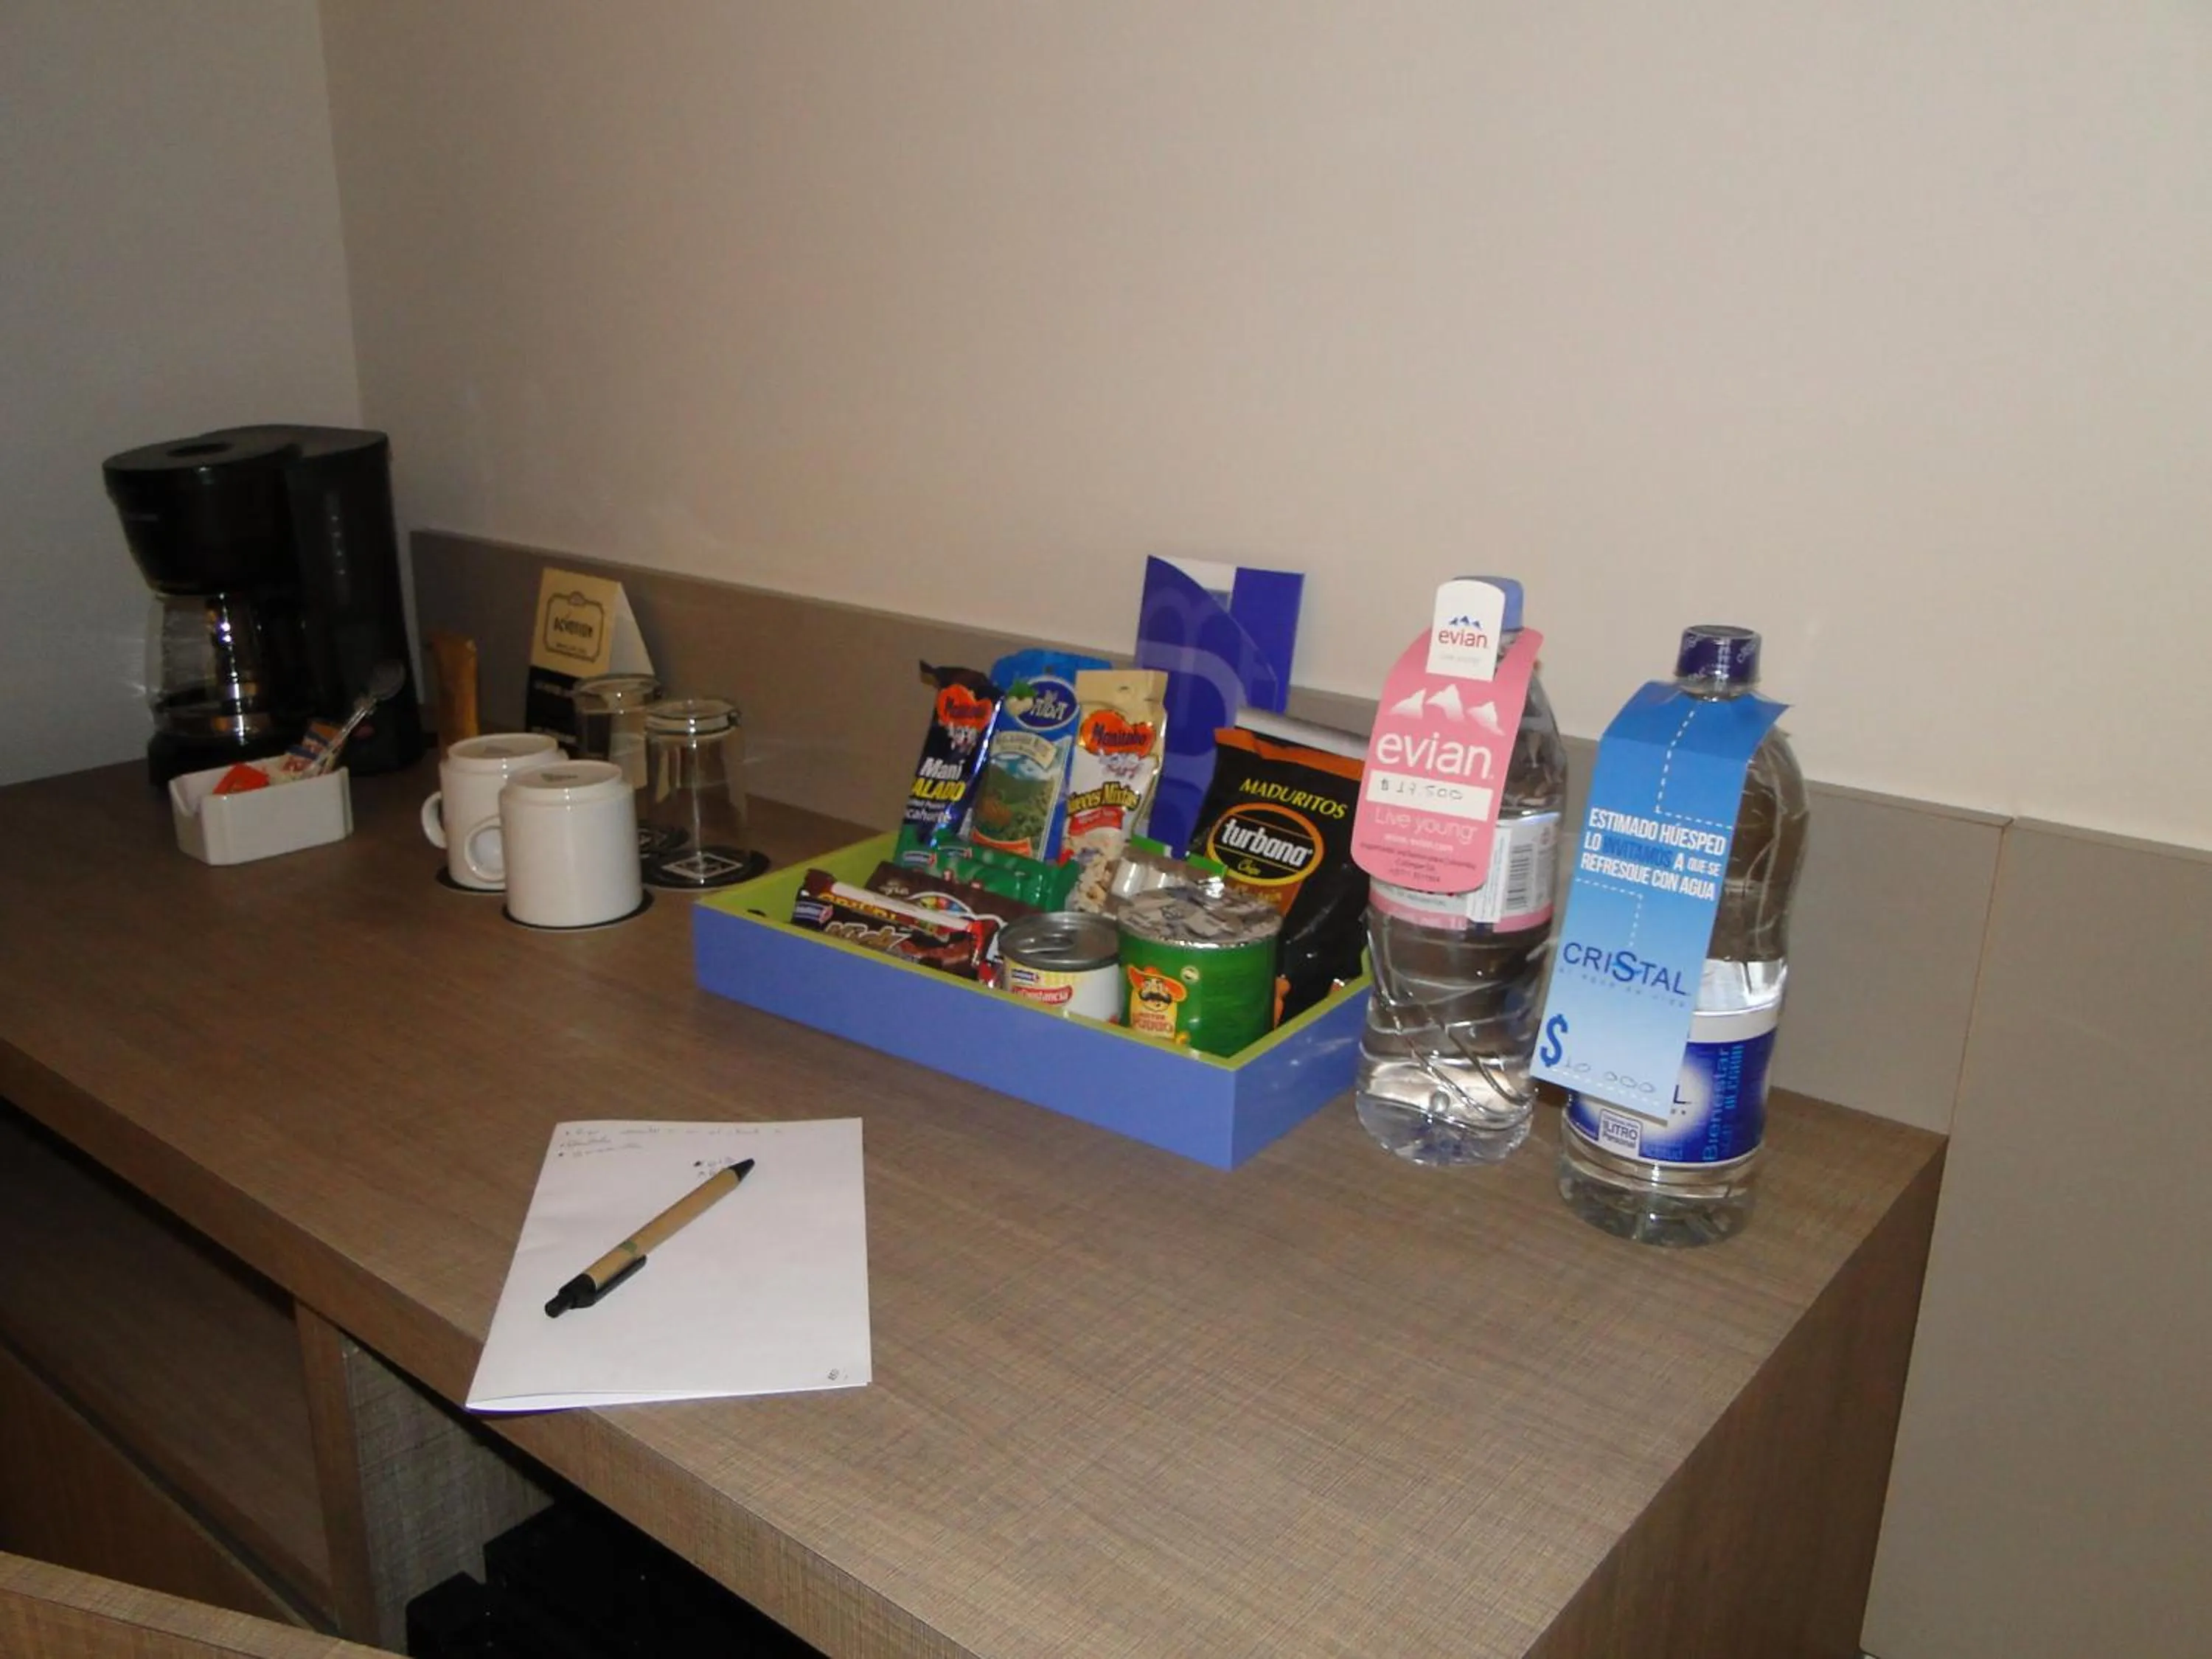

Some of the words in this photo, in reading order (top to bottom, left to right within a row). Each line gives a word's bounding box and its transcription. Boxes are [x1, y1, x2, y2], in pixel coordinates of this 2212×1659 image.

[1439, 628, 1488, 649] evian
[1377, 731, 1492, 780] evian
[911, 777, 967, 802] ALADO
[1239, 778, 1348, 818] MADURITOS
[1220, 818, 1310, 868] turbana
[1374, 807, 1411, 828] Live
[1413, 817, 1478, 845] young
[1588, 807, 1659, 841] ESTIMADO
[1584, 831, 1602, 851] LO
[1601, 834, 1674, 869] INVITAMOS
[1672, 852, 1685, 872] A
[1580, 852, 1652, 886] REFRESQUE
[1651, 869, 1680, 892] CON
[1679, 876, 1717, 902] AGUA
[1562, 942, 1687, 996] CRISTAL
[1540, 1013, 1569, 1068] $
